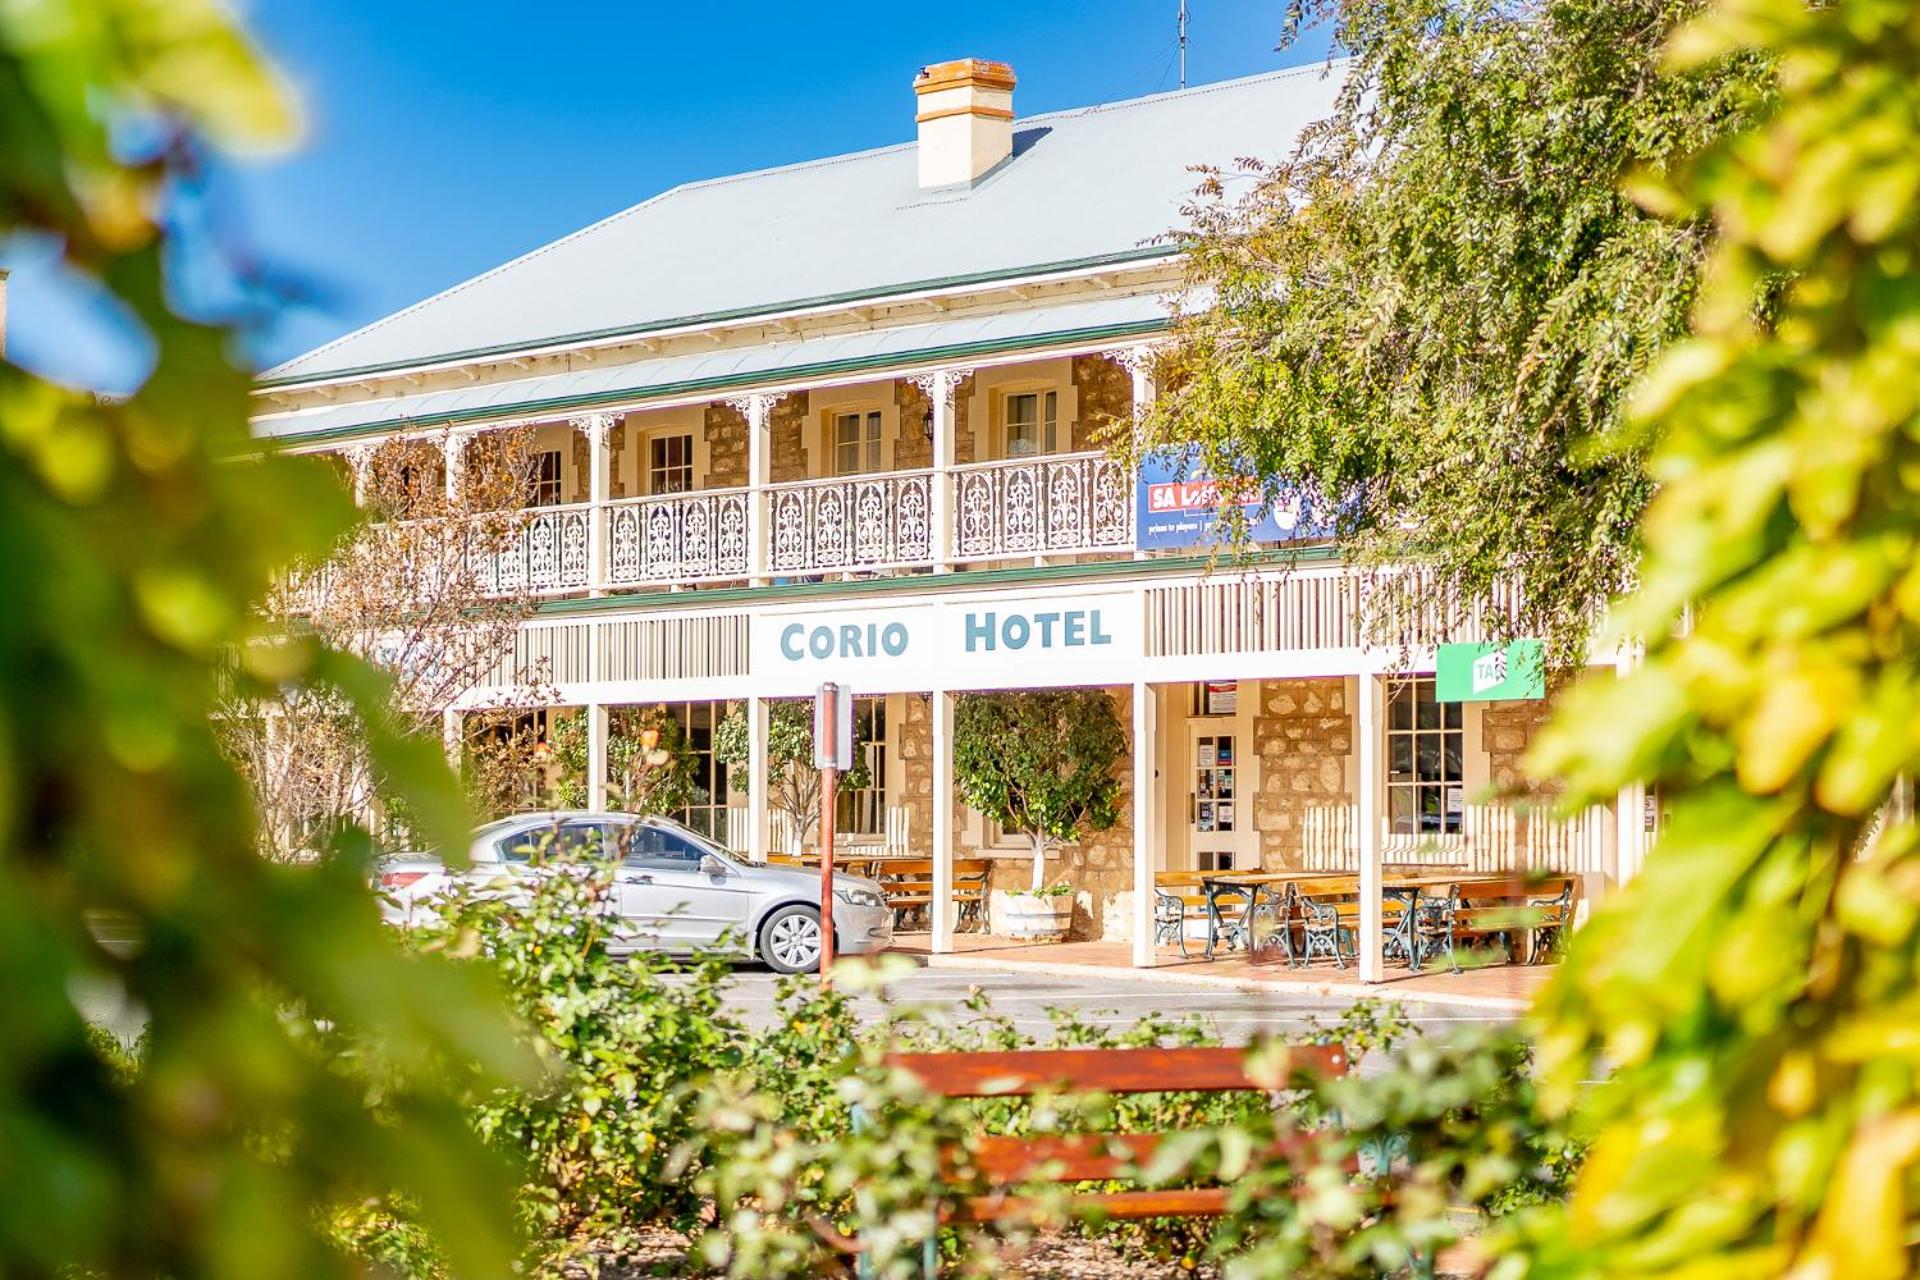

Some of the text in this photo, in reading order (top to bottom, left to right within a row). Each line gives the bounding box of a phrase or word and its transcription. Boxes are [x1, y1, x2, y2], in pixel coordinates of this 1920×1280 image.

[1153, 487, 1176, 508] SA
[780, 610, 1112, 661] CORIO HOTEL
